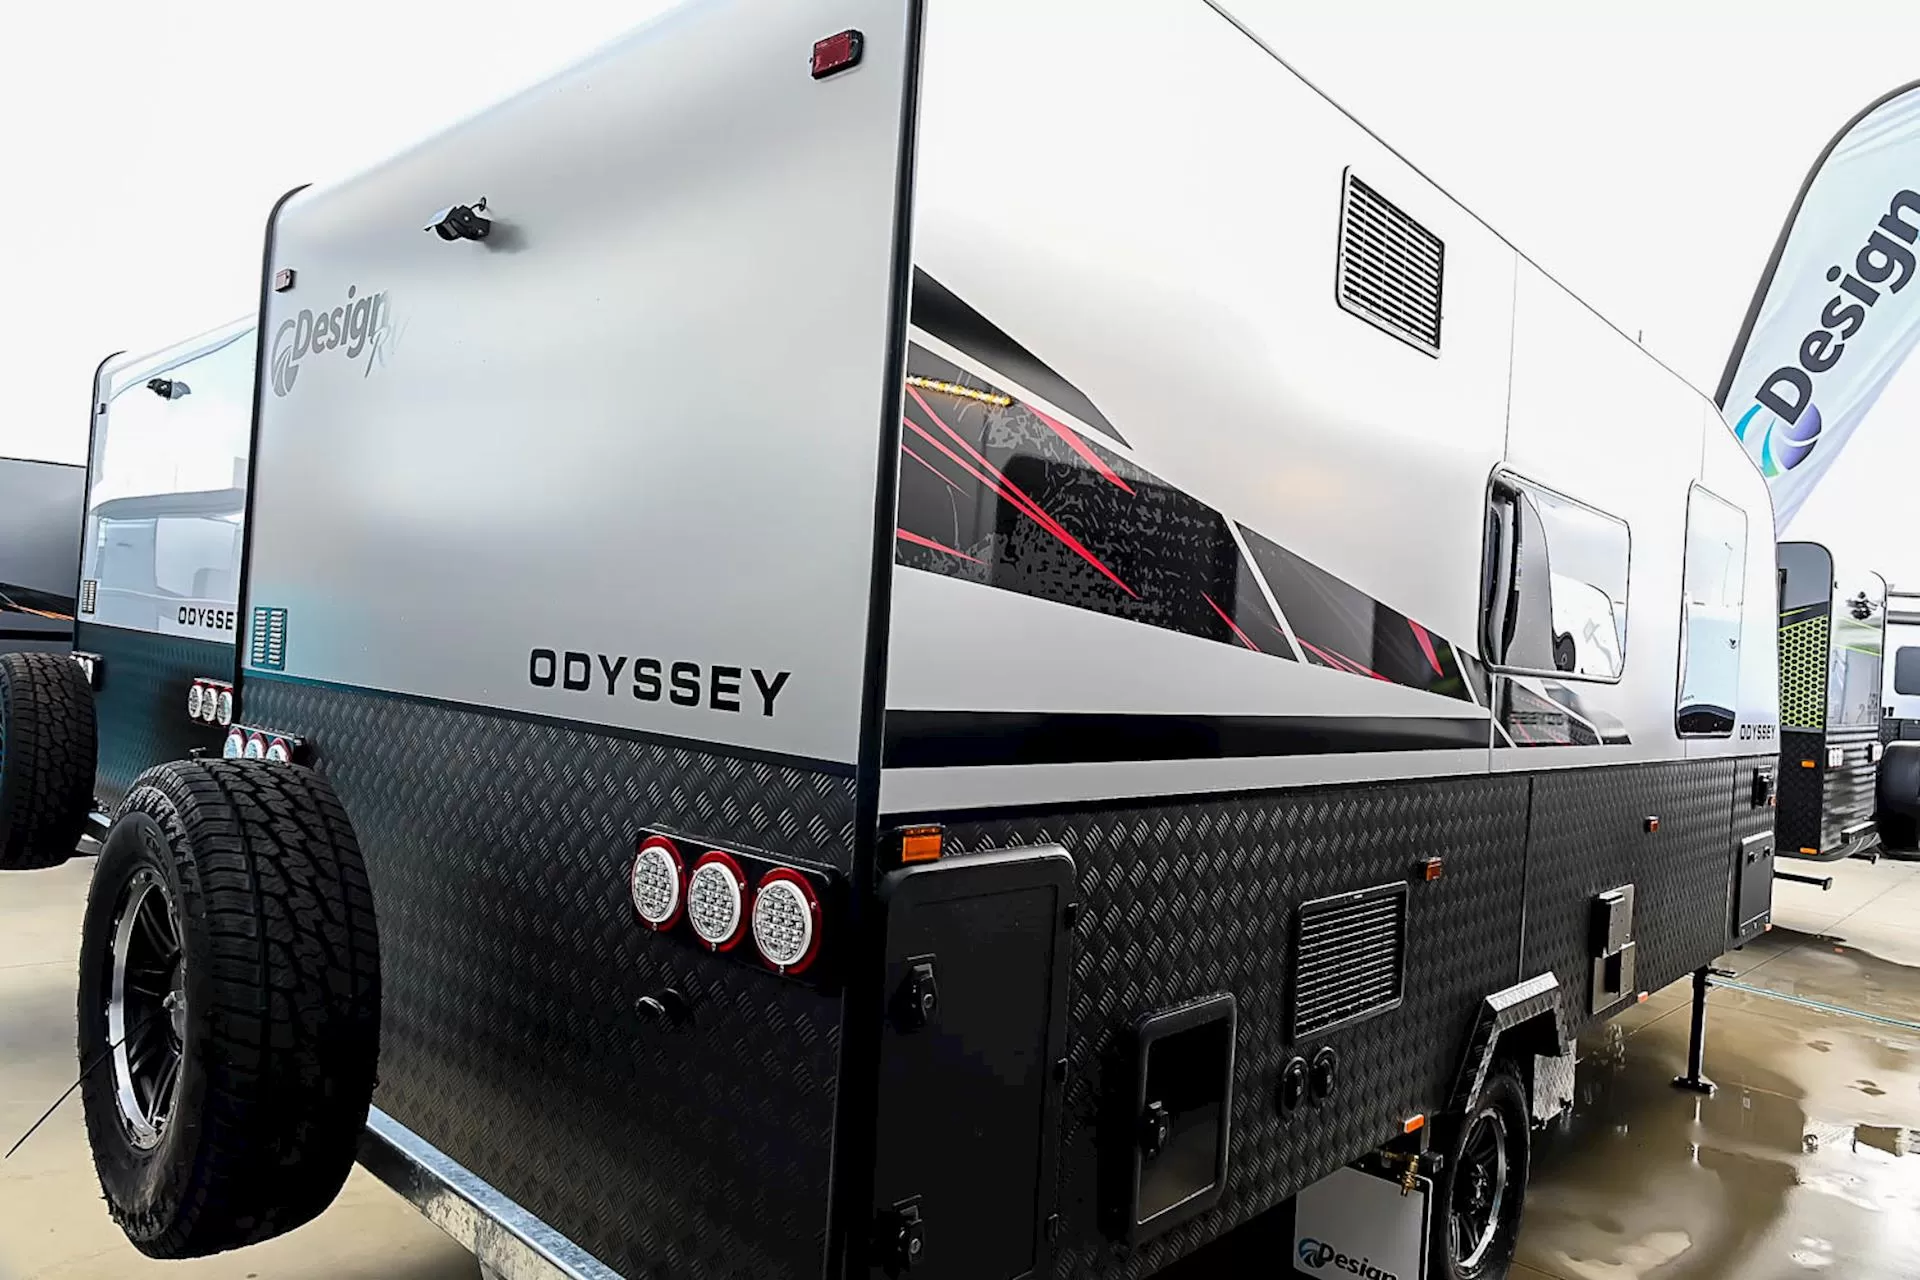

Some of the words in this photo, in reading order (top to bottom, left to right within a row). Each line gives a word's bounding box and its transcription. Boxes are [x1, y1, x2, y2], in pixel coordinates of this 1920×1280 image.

[291, 284, 391, 359] Design
[1754, 189, 1920, 426] Design
[178, 606, 237, 630] ODYSSE
[529, 648, 791, 717] ODYSSEY
[1740, 724, 1777, 740] ODYSSEY
